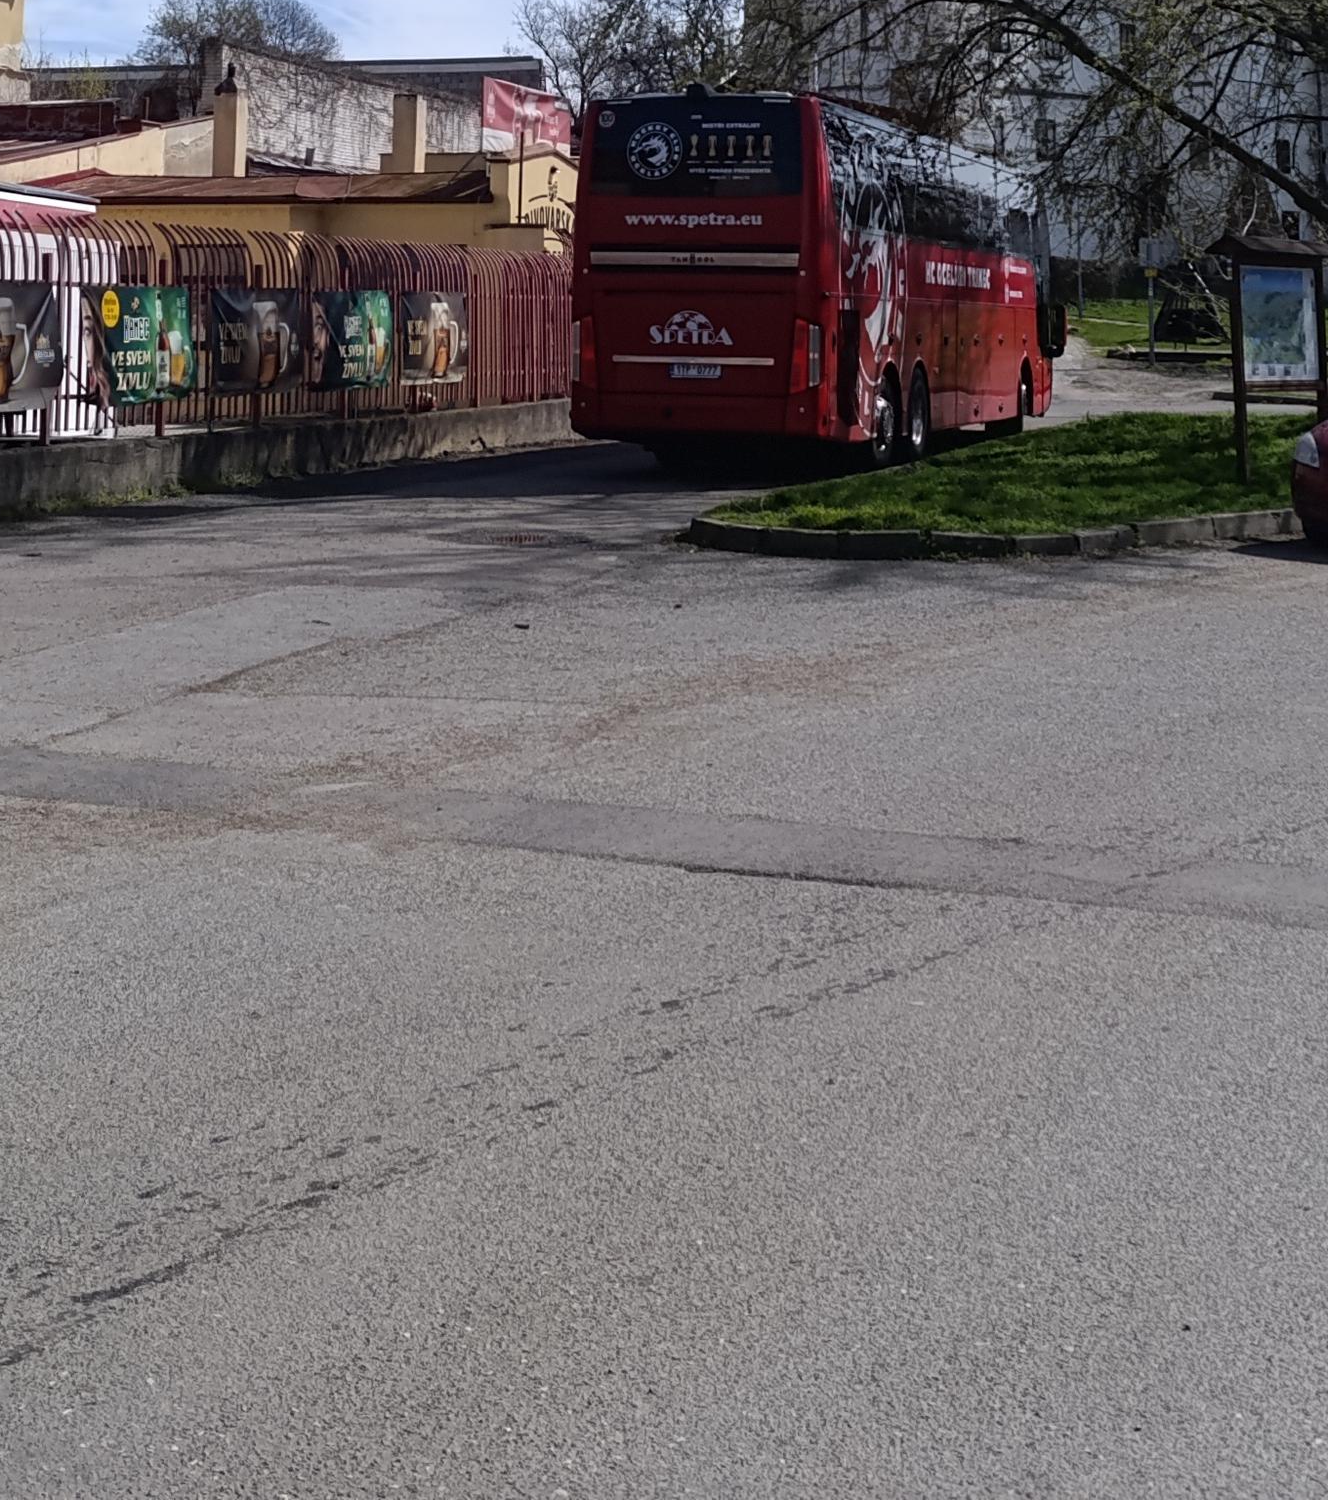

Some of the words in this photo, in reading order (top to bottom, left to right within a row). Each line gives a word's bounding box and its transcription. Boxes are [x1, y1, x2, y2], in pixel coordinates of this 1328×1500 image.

[624, 211, 763, 229] www.spetra.eu
[649, 324, 734, 346] SPETRA
[111, 351, 125, 367] VE
[126, 348, 152, 366] SVÉM
